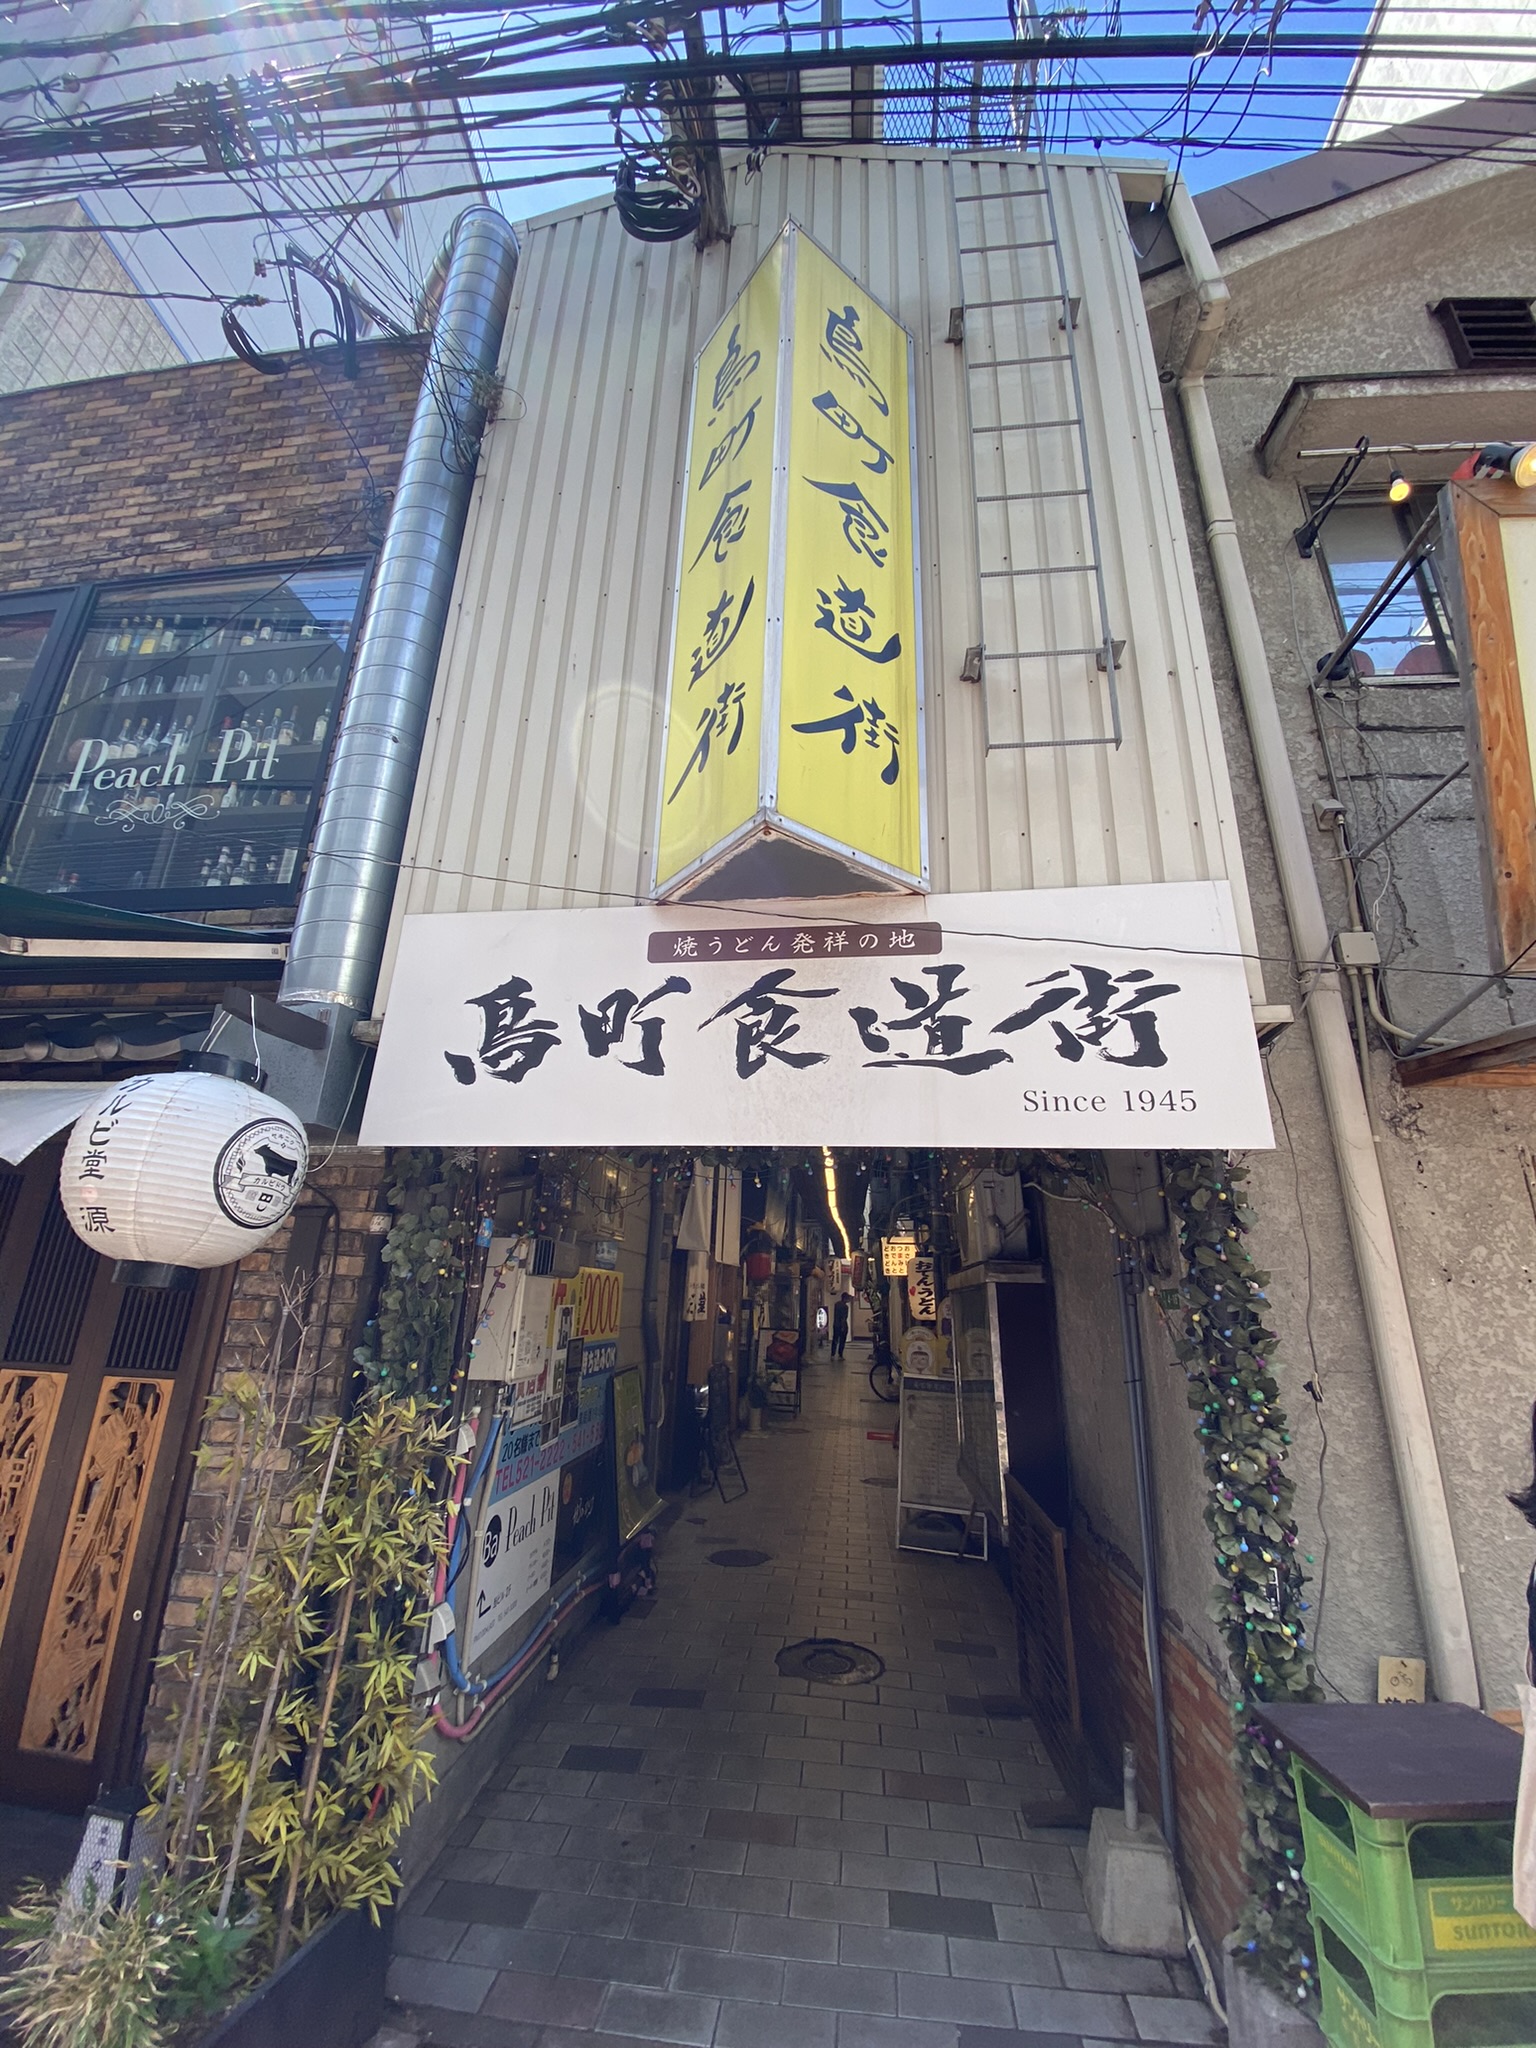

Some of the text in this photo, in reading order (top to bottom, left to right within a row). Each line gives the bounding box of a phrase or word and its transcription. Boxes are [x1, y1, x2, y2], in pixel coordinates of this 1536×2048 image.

[62, 728, 280, 793] Peach Pit
[672, 929, 917, 957] 焼うどん発祥の地
[1022, 1089, 1198, 1112] Since 1945
[580, 1273, 620, 1336] 2000
[504, 1494, 536, 1554] Peach
[539, 1485, 556, 1528] Pit
